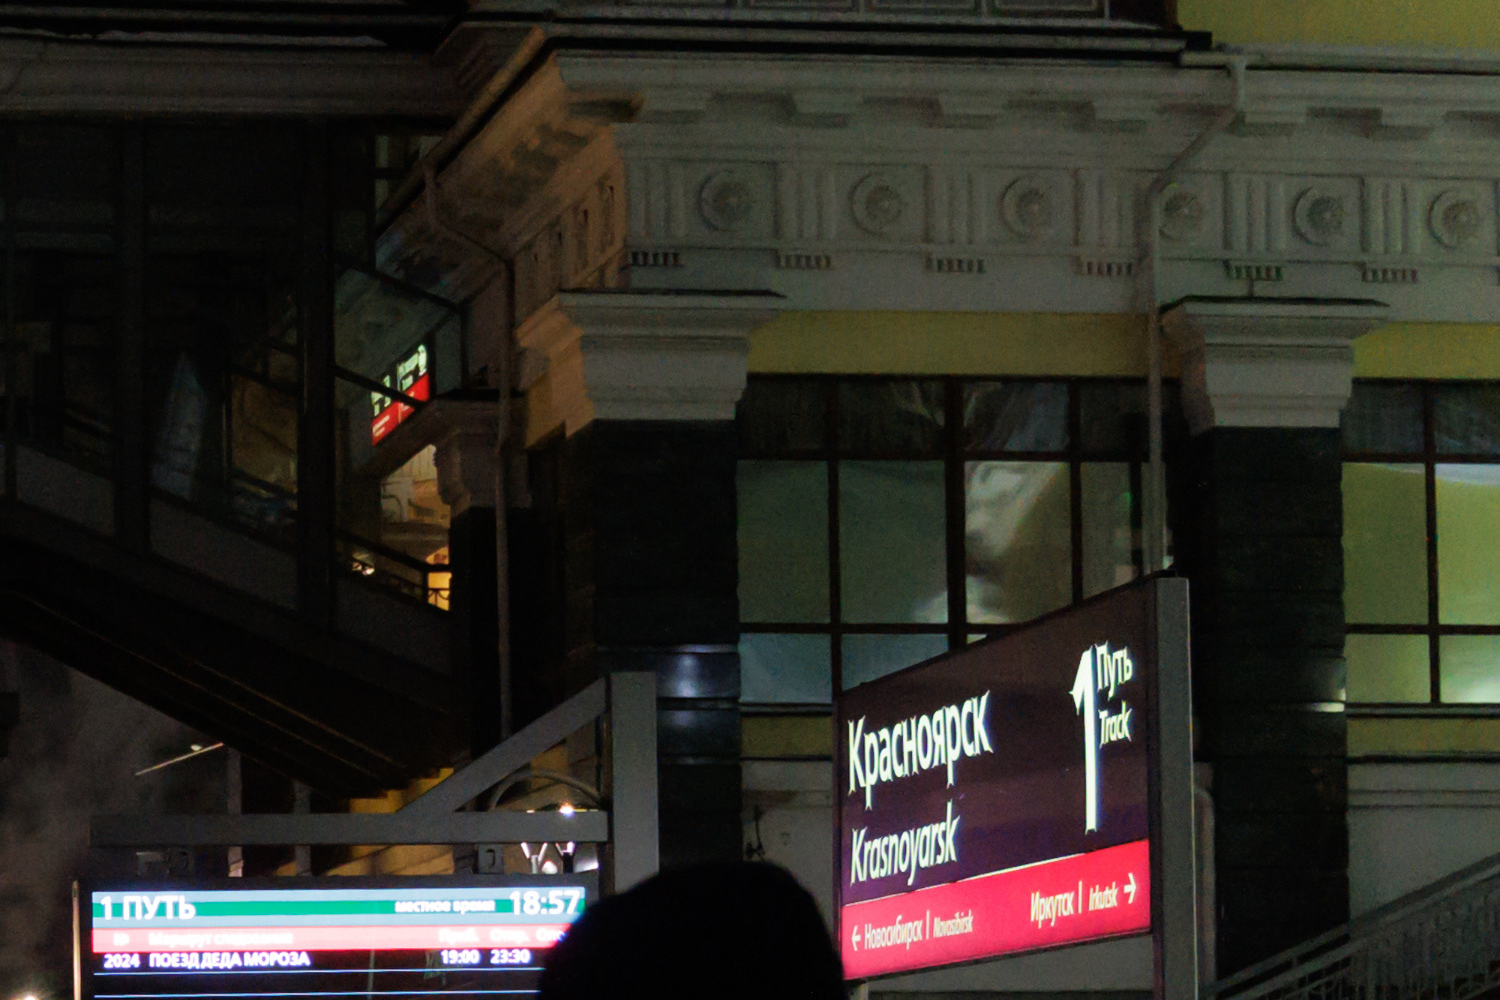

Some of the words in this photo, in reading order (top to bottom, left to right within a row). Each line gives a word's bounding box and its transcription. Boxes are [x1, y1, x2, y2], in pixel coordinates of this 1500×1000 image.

[1095, 640, 1133, 700] Путь
[1069, 644, 1098, 835] 1
[1099, 701, 1133, 749] Track
[847, 690, 994, 811] Красноярск
[850, 801, 961, 887] Krasnoyarsk
[100, 896, 113, 920] 1
[123, 895, 196, 920] ПУТЬ
[395, 901, 451, 913] местное
[453, 900, 495, 914] время
[509, 890, 580, 916] 18:57
[1030, 890, 1075, 929] Иркутск
[1088, 882, 1119, 912] Irkutsk
[864, 915, 923, 950] Новосибирск
[933, 910, 974, 938] Novosibirsk
[104, 953, 140, 968] 2024
[149, 953, 199, 970] ПОЕЗД
[199, 953, 242, 970] ДЕДА
[244, 951, 311, 967] МОРОЗА
[441, 950, 480, 964] 19:00
[490, 949, 531, 964] 23:30
